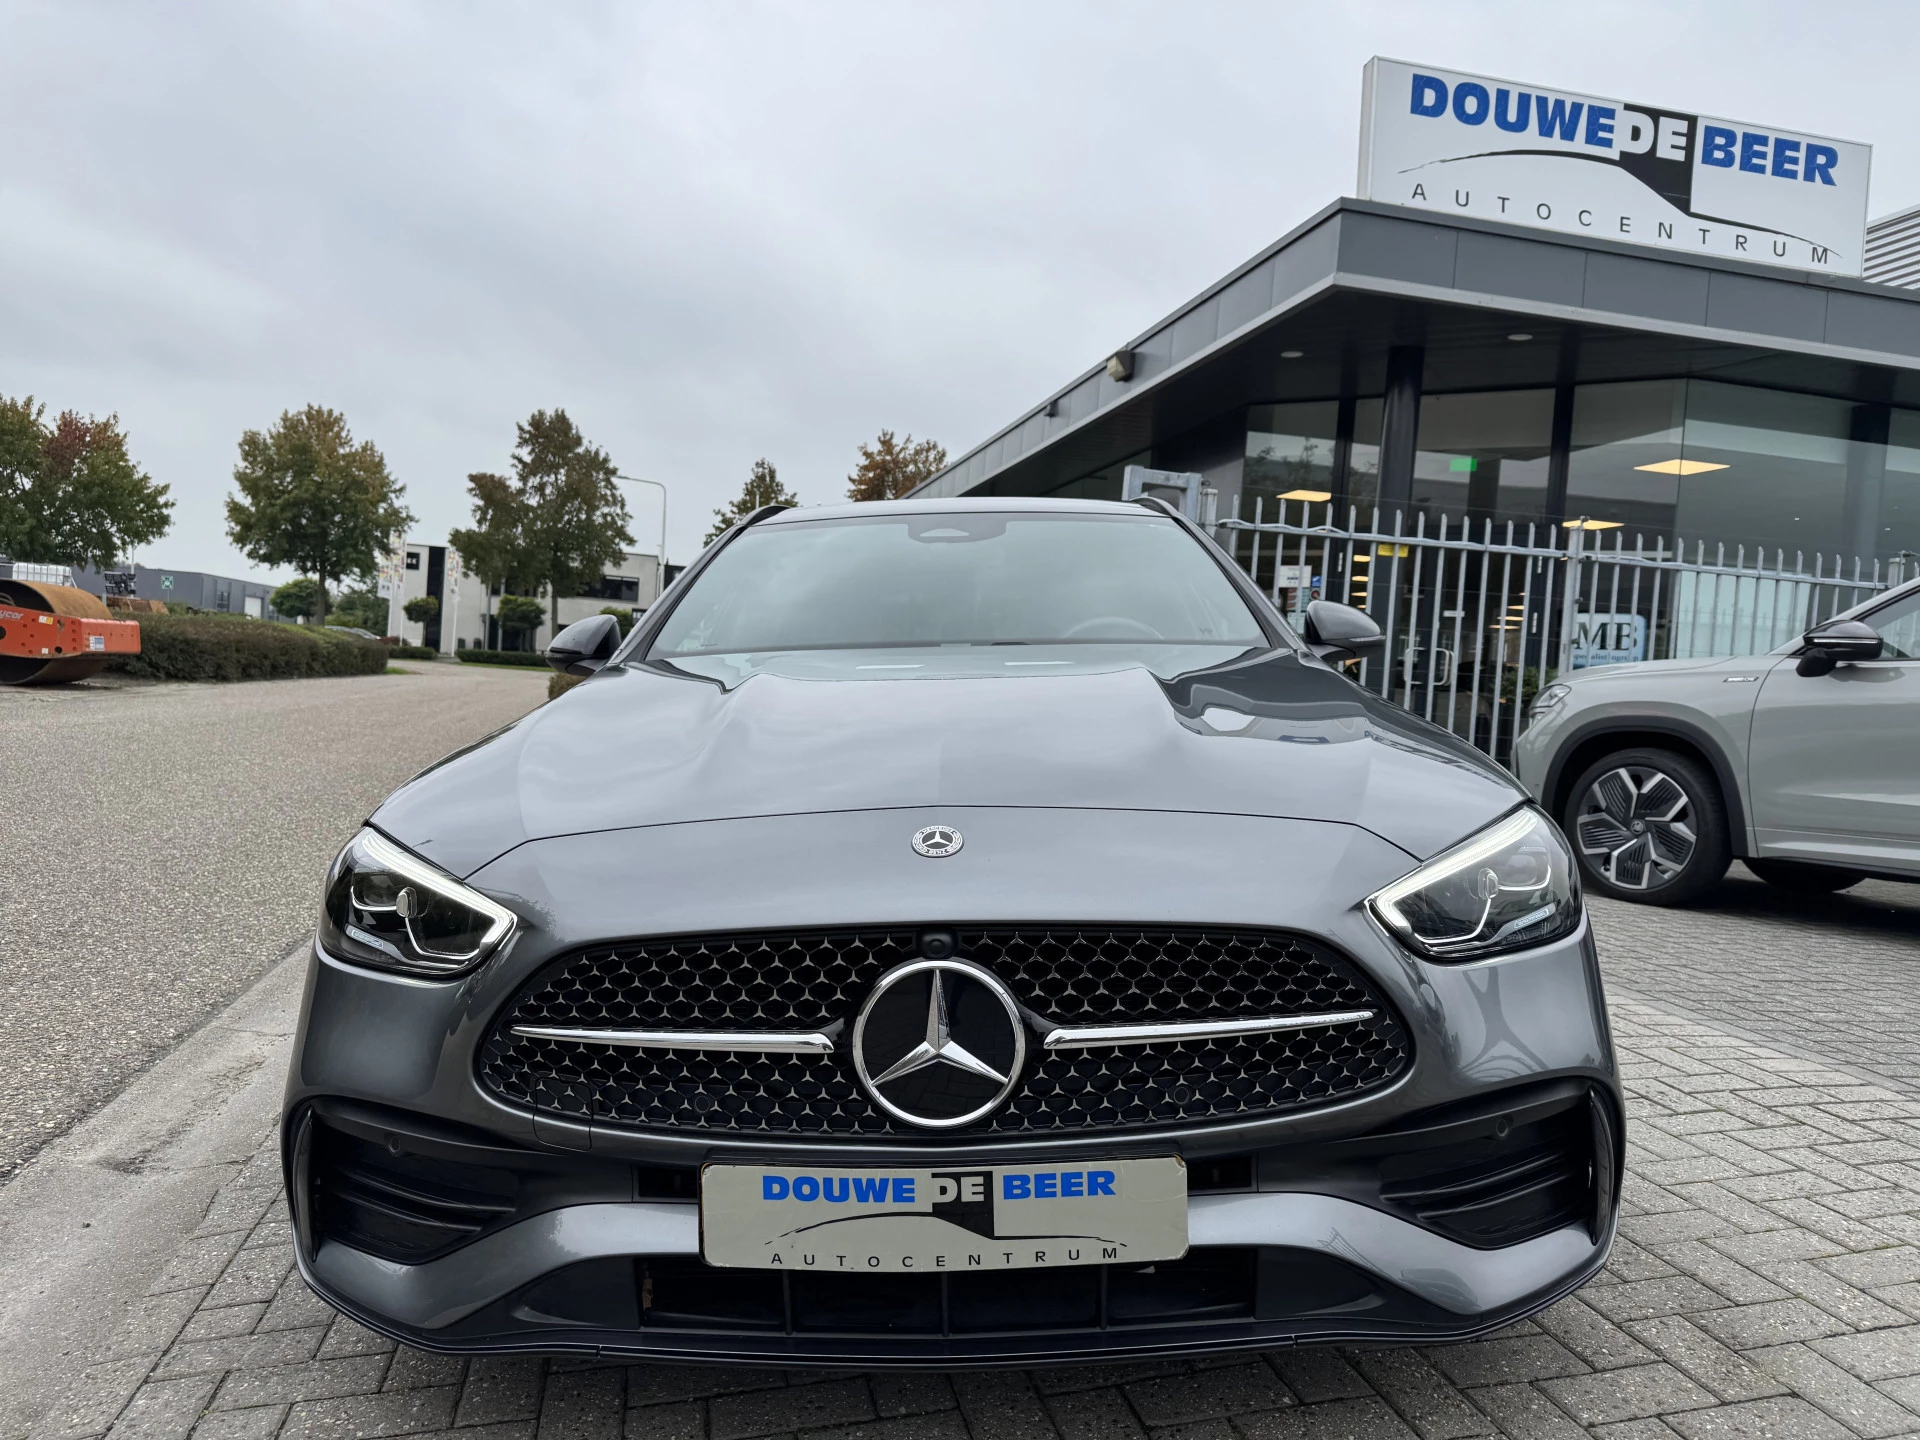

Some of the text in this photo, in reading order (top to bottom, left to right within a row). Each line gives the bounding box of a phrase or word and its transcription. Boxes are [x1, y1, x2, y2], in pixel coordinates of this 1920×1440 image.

[1410, 73, 1839, 187] DOUWE DE BEER
[1411, 183, 1829, 265] AUTOCENTRUM
[762, 1170, 1117, 1204] DOUWE DE BEER
[771, 1247, 1118, 1268] AUTOCENTRUM
